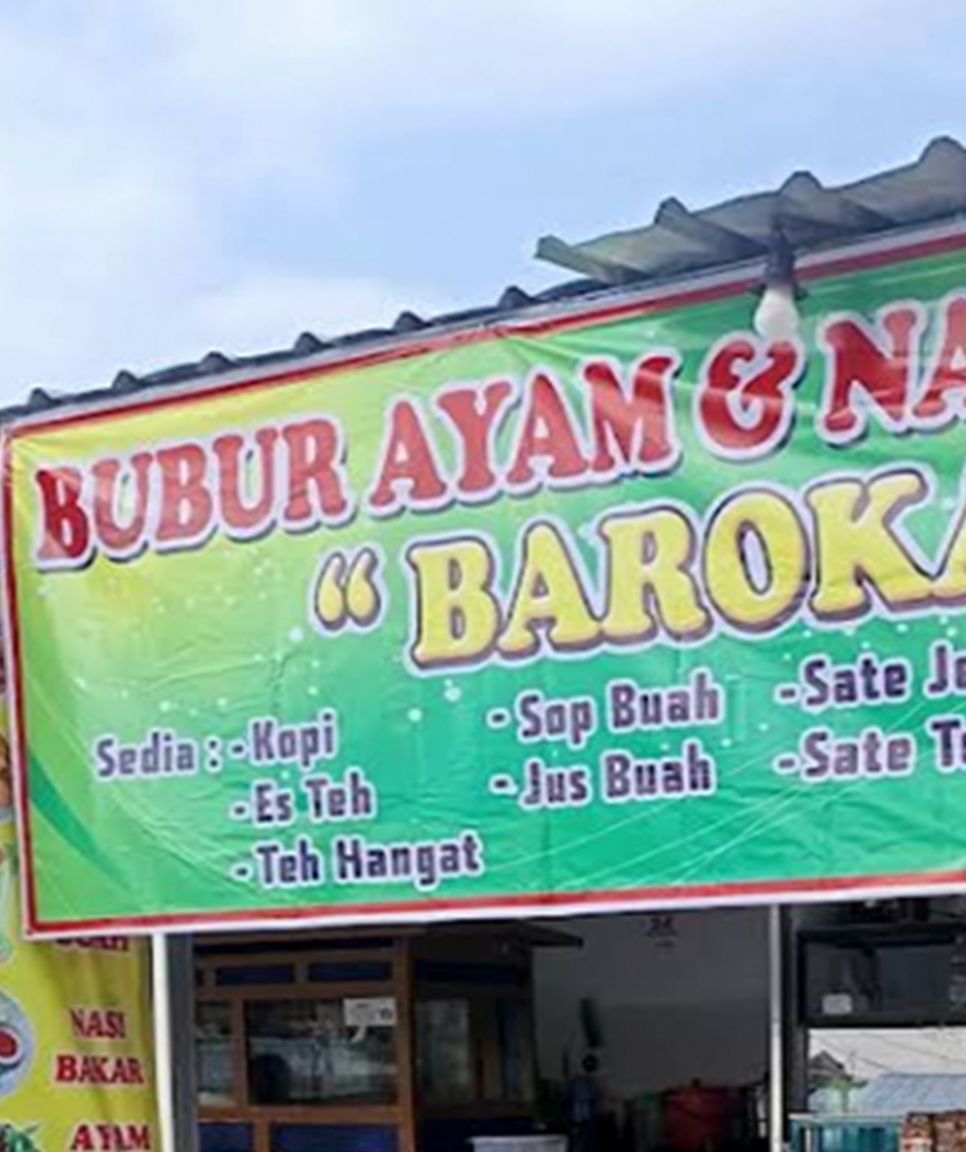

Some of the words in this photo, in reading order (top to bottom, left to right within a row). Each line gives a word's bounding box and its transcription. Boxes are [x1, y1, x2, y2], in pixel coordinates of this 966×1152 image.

[33, 416, 352, 564] BUBUR
[369, 354, 681, 508] AYAM
[699, 338, 798, 452] &
[611, 672, 720, 730] Buah
[96, 732, 196, 779] Sedia
[605, 745, 713, 799] Buah
[306, 773, 374, 820] Teh
[334, 833, 483, 890] Hangat
[70, 1008, 127, 1040] NASI
[55, 1053, 145, 1084] BAKAR
